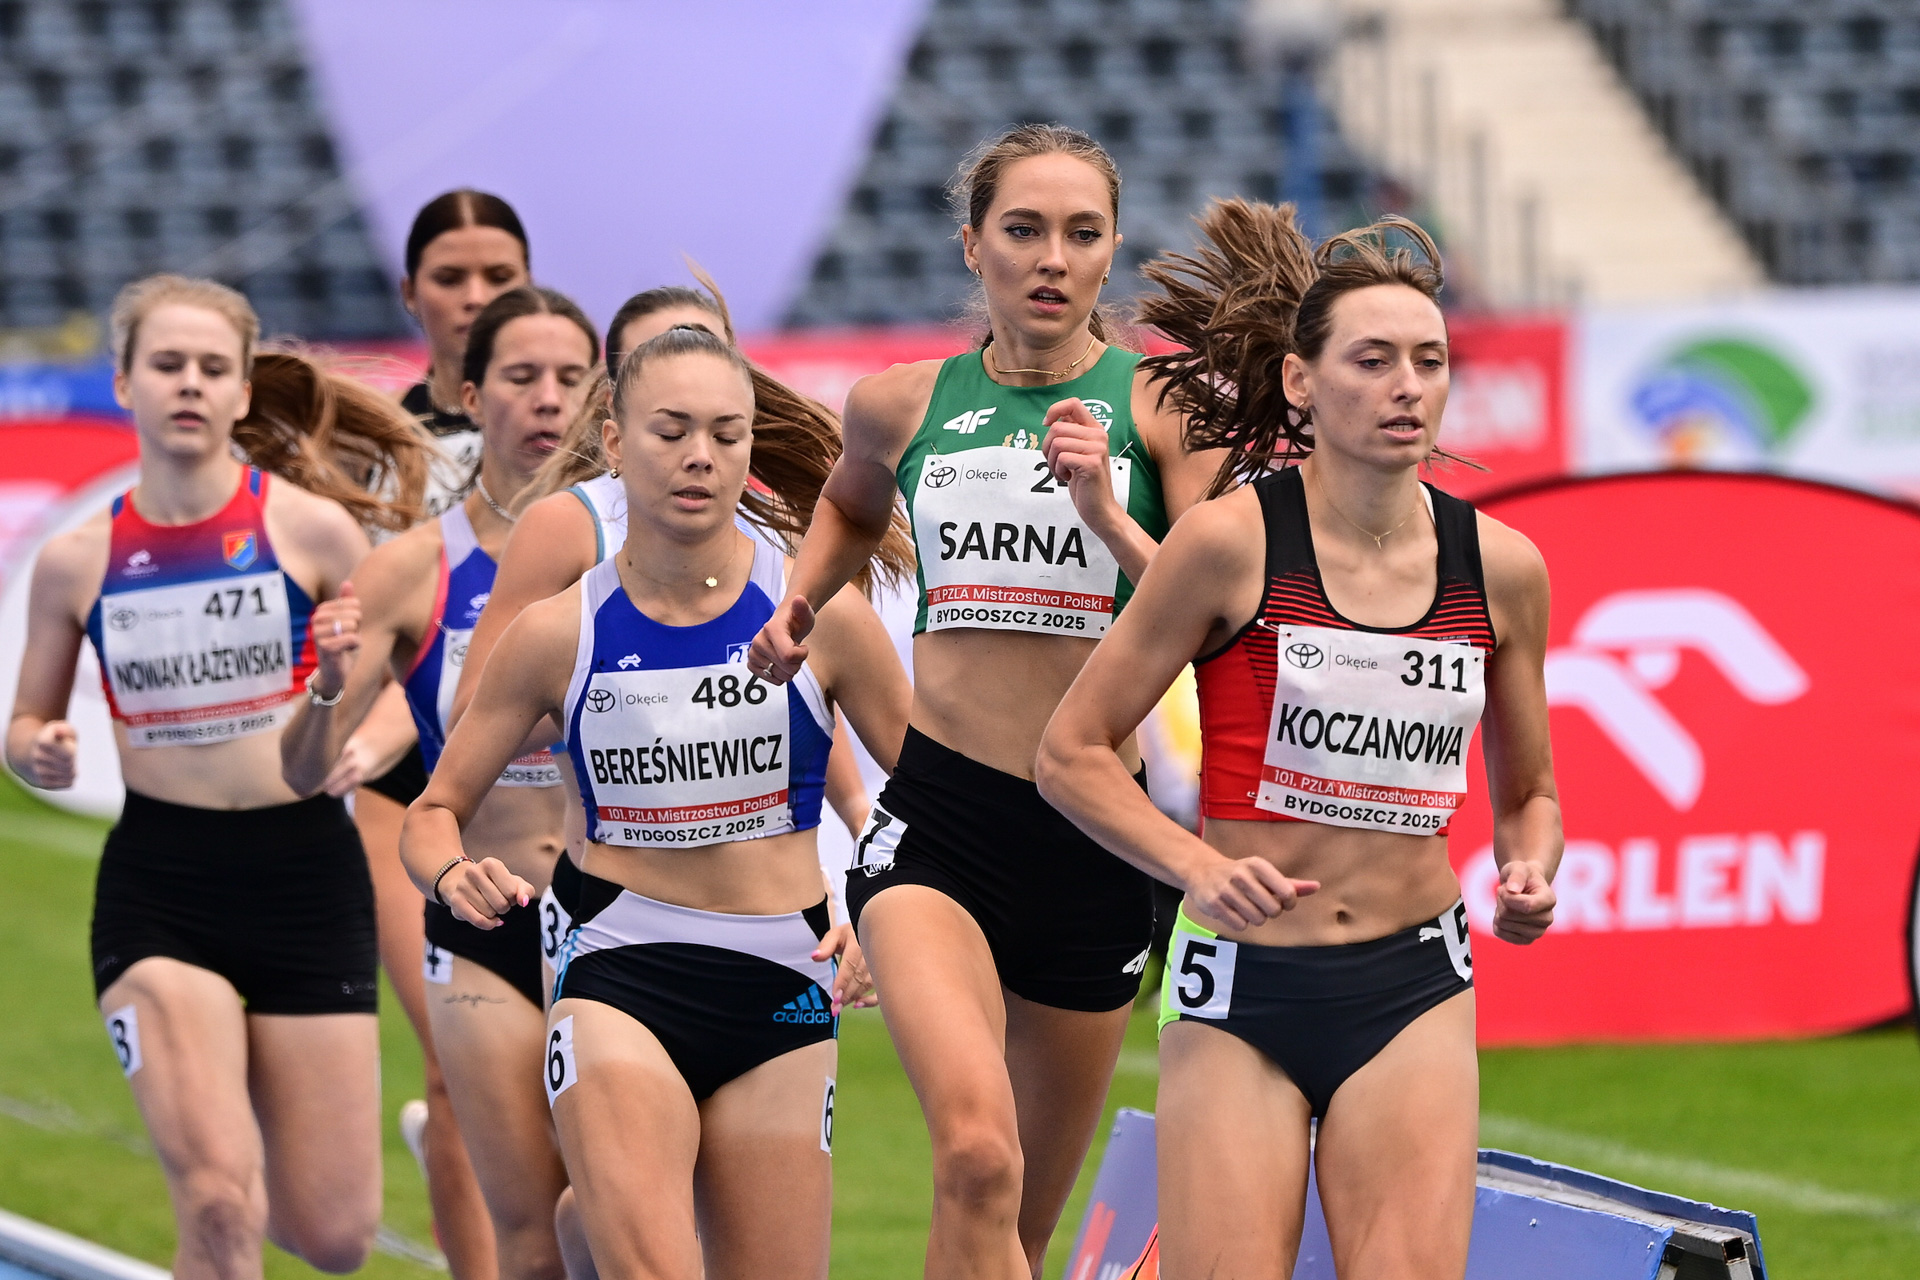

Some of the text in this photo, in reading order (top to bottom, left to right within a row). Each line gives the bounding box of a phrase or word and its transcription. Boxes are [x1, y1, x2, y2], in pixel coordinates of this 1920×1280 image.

[965, 468, 1008, 482] Okęcie
[939, 521, 1088, 568] SARNA
[204, 586, 270, 620] 471
[942, 587, 969, 601] PZLA
[973, 587, 1060, 606] Mistrzostwa
[1063, 595, 1103, 611] Polski
[936, 607, 1086, 631] BYDGOSZCZ 2025
[1335, 654, 1378, 670] Okęcie
[1400, 650, 1467, 694] 311
[625, 692, 669, 706] Okęcie
[691, 674, 768, 710] 486
[1276, 702, 1464, 766] KOCZANOWA
[589, 733, 783, 786] BEREŚNIEWICZ
[1273, 769, 1457, 808] 101. PZLA Mistrzostwa Polski
[607, 792, 780, 823] 101. PZLA Mistrzostwa Polski
[1284, 794, 1441, 830] BYDGOSZCZ 2025
[623, 815, 766, 843] BYDGOSZCZ 2025
[857, 807, 893, 866] 7
[546, 902, 559, 958] 3
[1177, 940, 1218, 1009] 5
[773, 1010, 830, 1024] adidas
[548, 1030, 565, 1093] 6
[824, 1085, 835, 1149] 6
